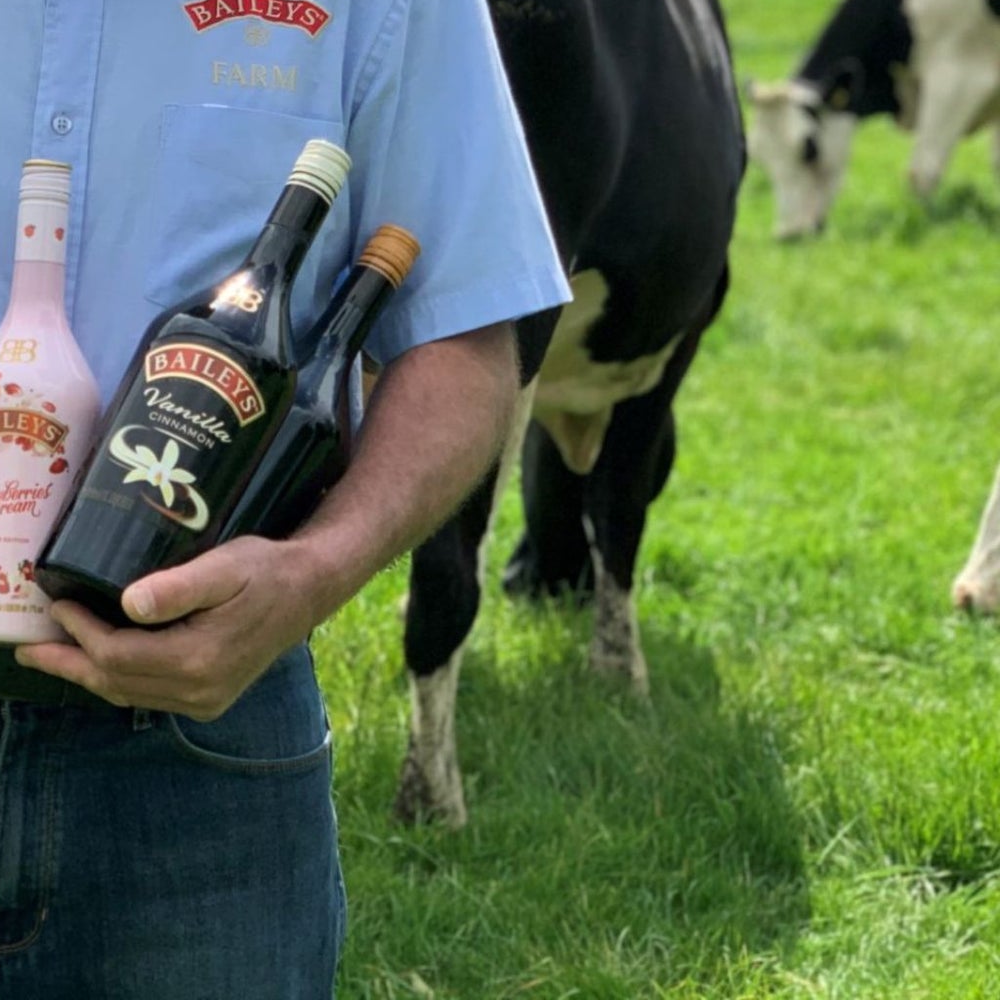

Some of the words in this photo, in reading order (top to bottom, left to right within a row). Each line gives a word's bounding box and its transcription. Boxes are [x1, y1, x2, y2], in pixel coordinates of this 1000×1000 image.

[211, 60, 298, 92] FARM
[153, 351, 258, 413] BAILEYS
[143, 386, 232, 443] Vanilla
[148, 411, 215, 450] CINNAMON
